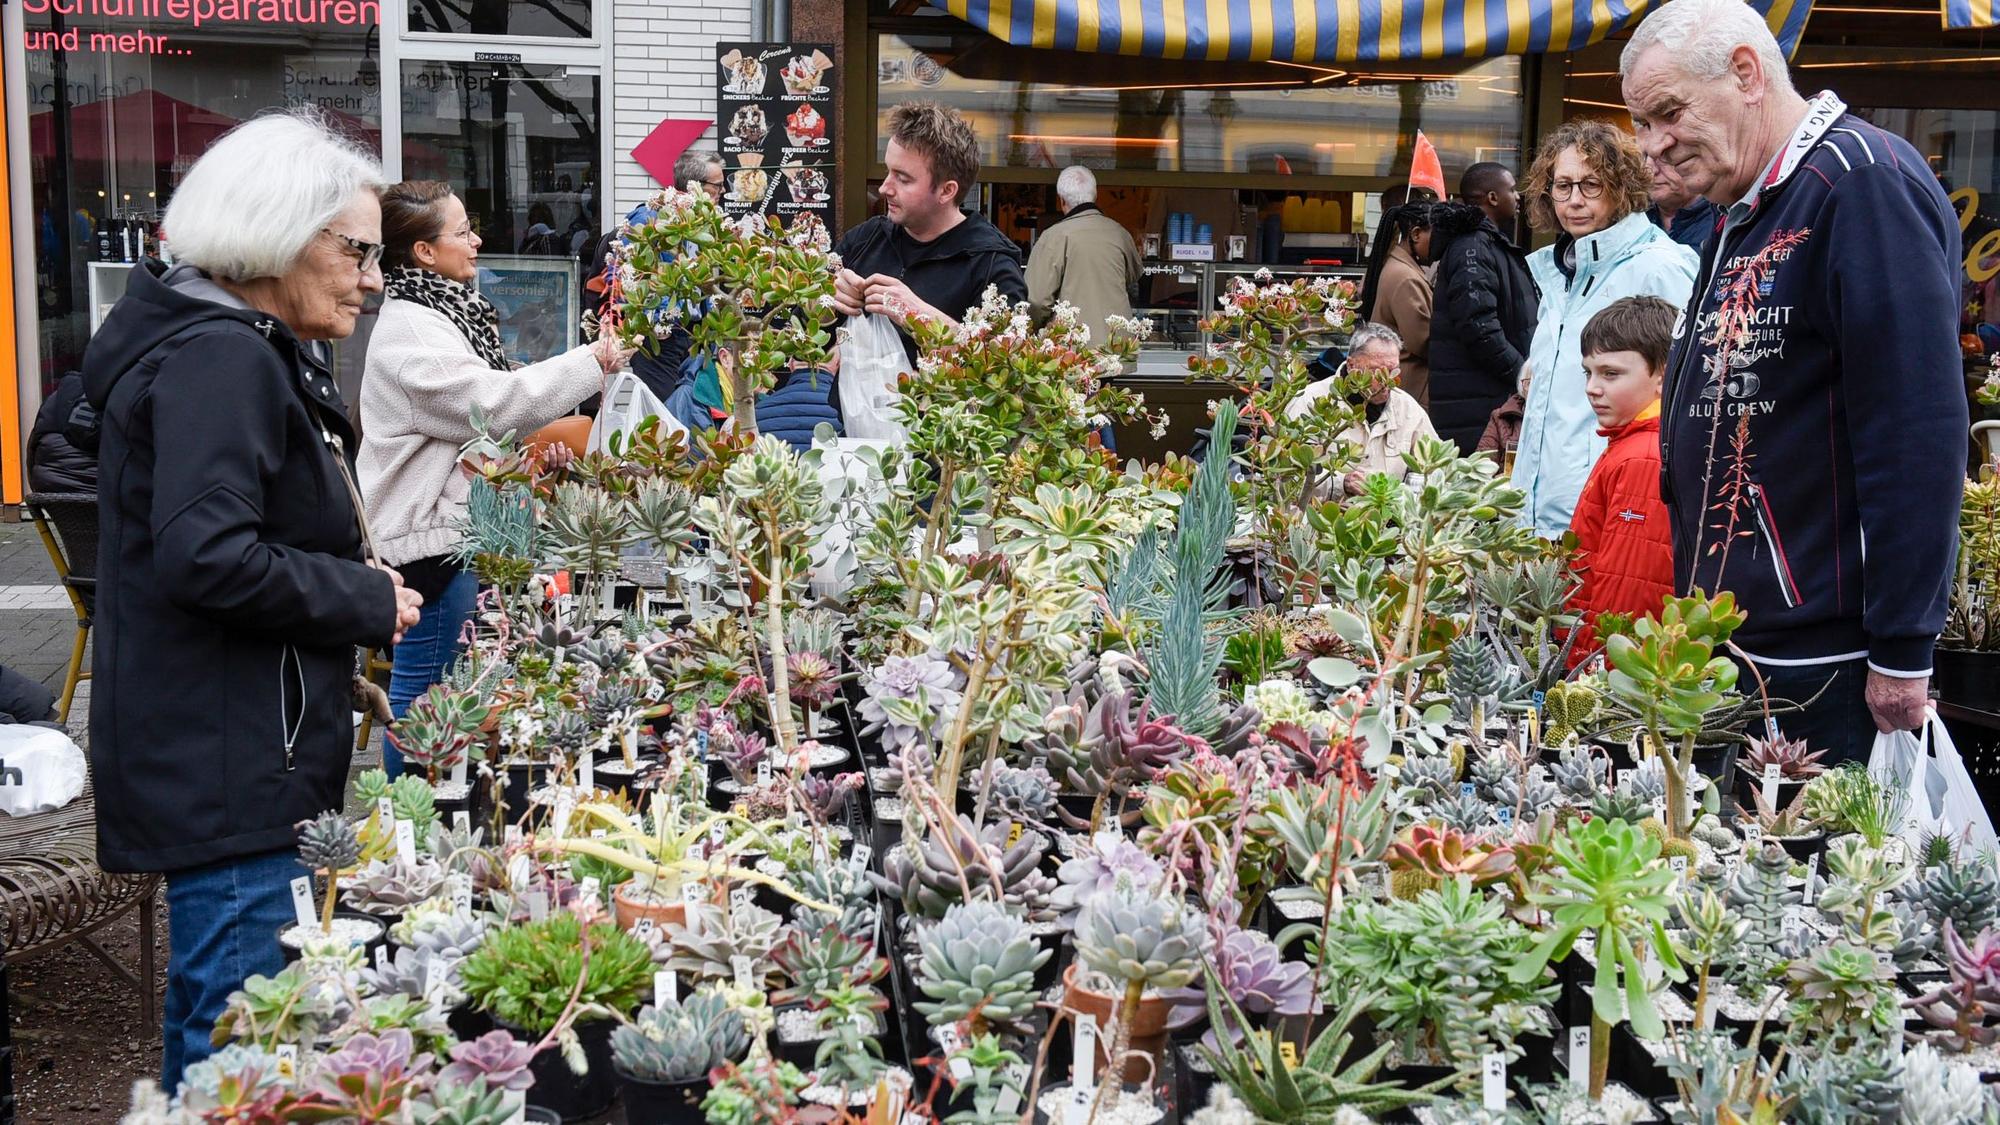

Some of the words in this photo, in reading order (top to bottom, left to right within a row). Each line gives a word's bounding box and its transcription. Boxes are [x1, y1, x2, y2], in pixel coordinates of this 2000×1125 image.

[24, 27, 80, 51] und
[90, 29, 192, 56] mehr...
[1164, 265, 1184, 276] 1,50
[489, 284, 554, 298] versohlen
[1727, 400, 1777, 417] CREW
